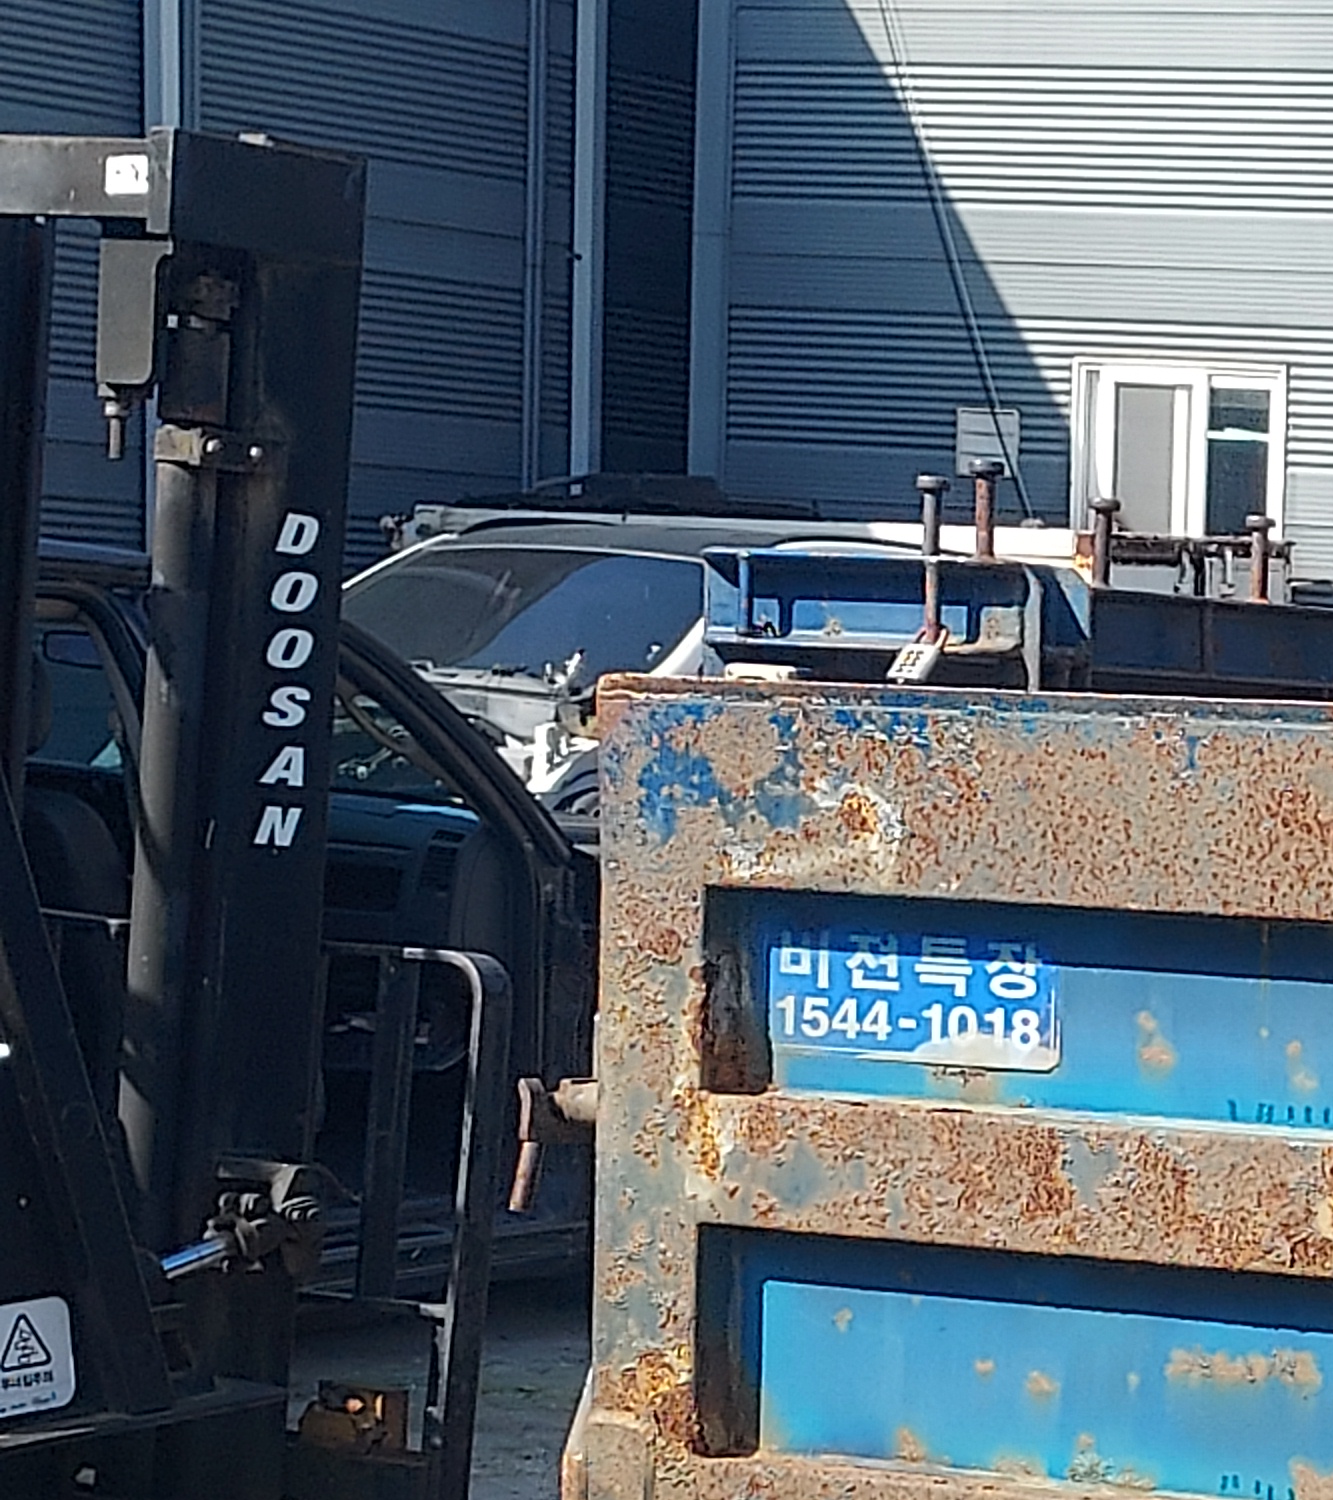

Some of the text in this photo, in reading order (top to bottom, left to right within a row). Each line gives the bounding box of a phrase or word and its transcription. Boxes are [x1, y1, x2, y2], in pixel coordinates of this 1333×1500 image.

[253, 512, 320, 847] DOOSAN
[778, 929, 1043, 1000] 비전특장
[776, 994, 1041, 1052] 1544-1018
